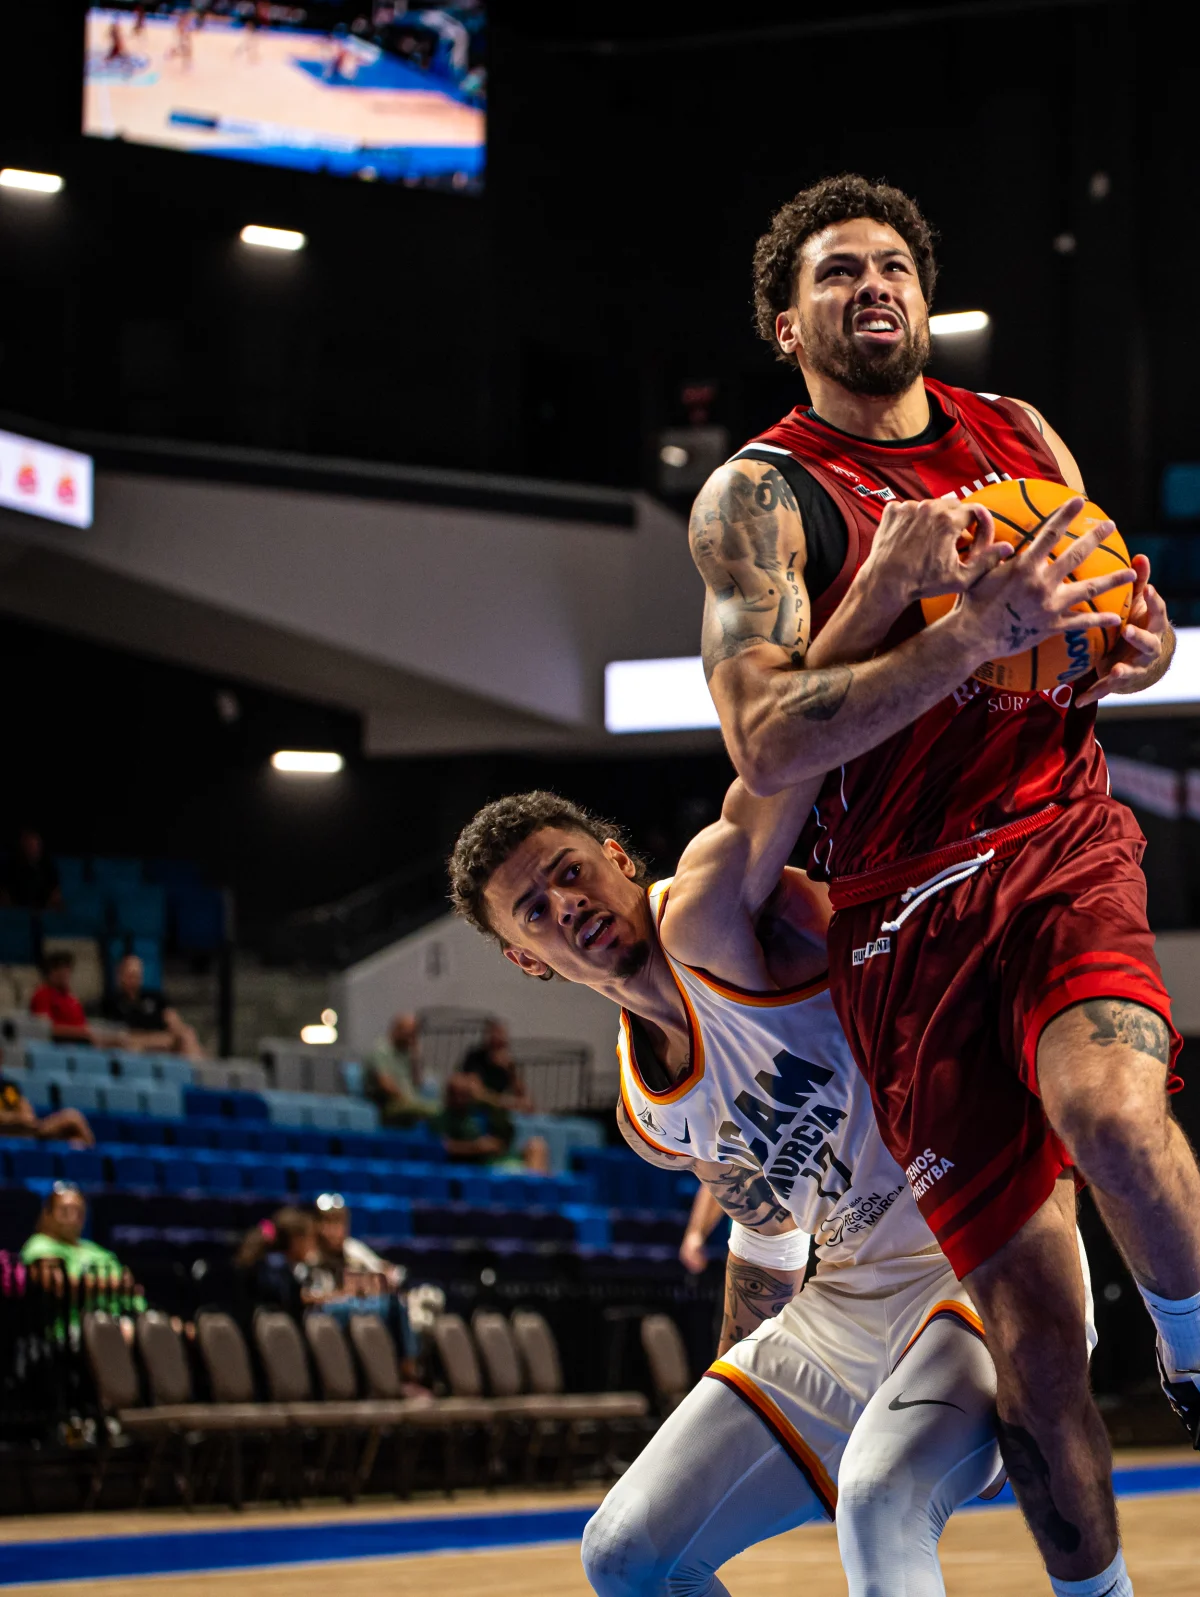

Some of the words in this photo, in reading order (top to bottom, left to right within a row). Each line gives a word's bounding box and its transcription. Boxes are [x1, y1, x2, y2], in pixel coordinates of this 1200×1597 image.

[766, 1104, 848, 1200] MURCIA
[844, 1192, 882, 1227] REGIÓN
[847, 1223, 866, 1234] DE
[863, 1185, 905, 1226] MURCIA
